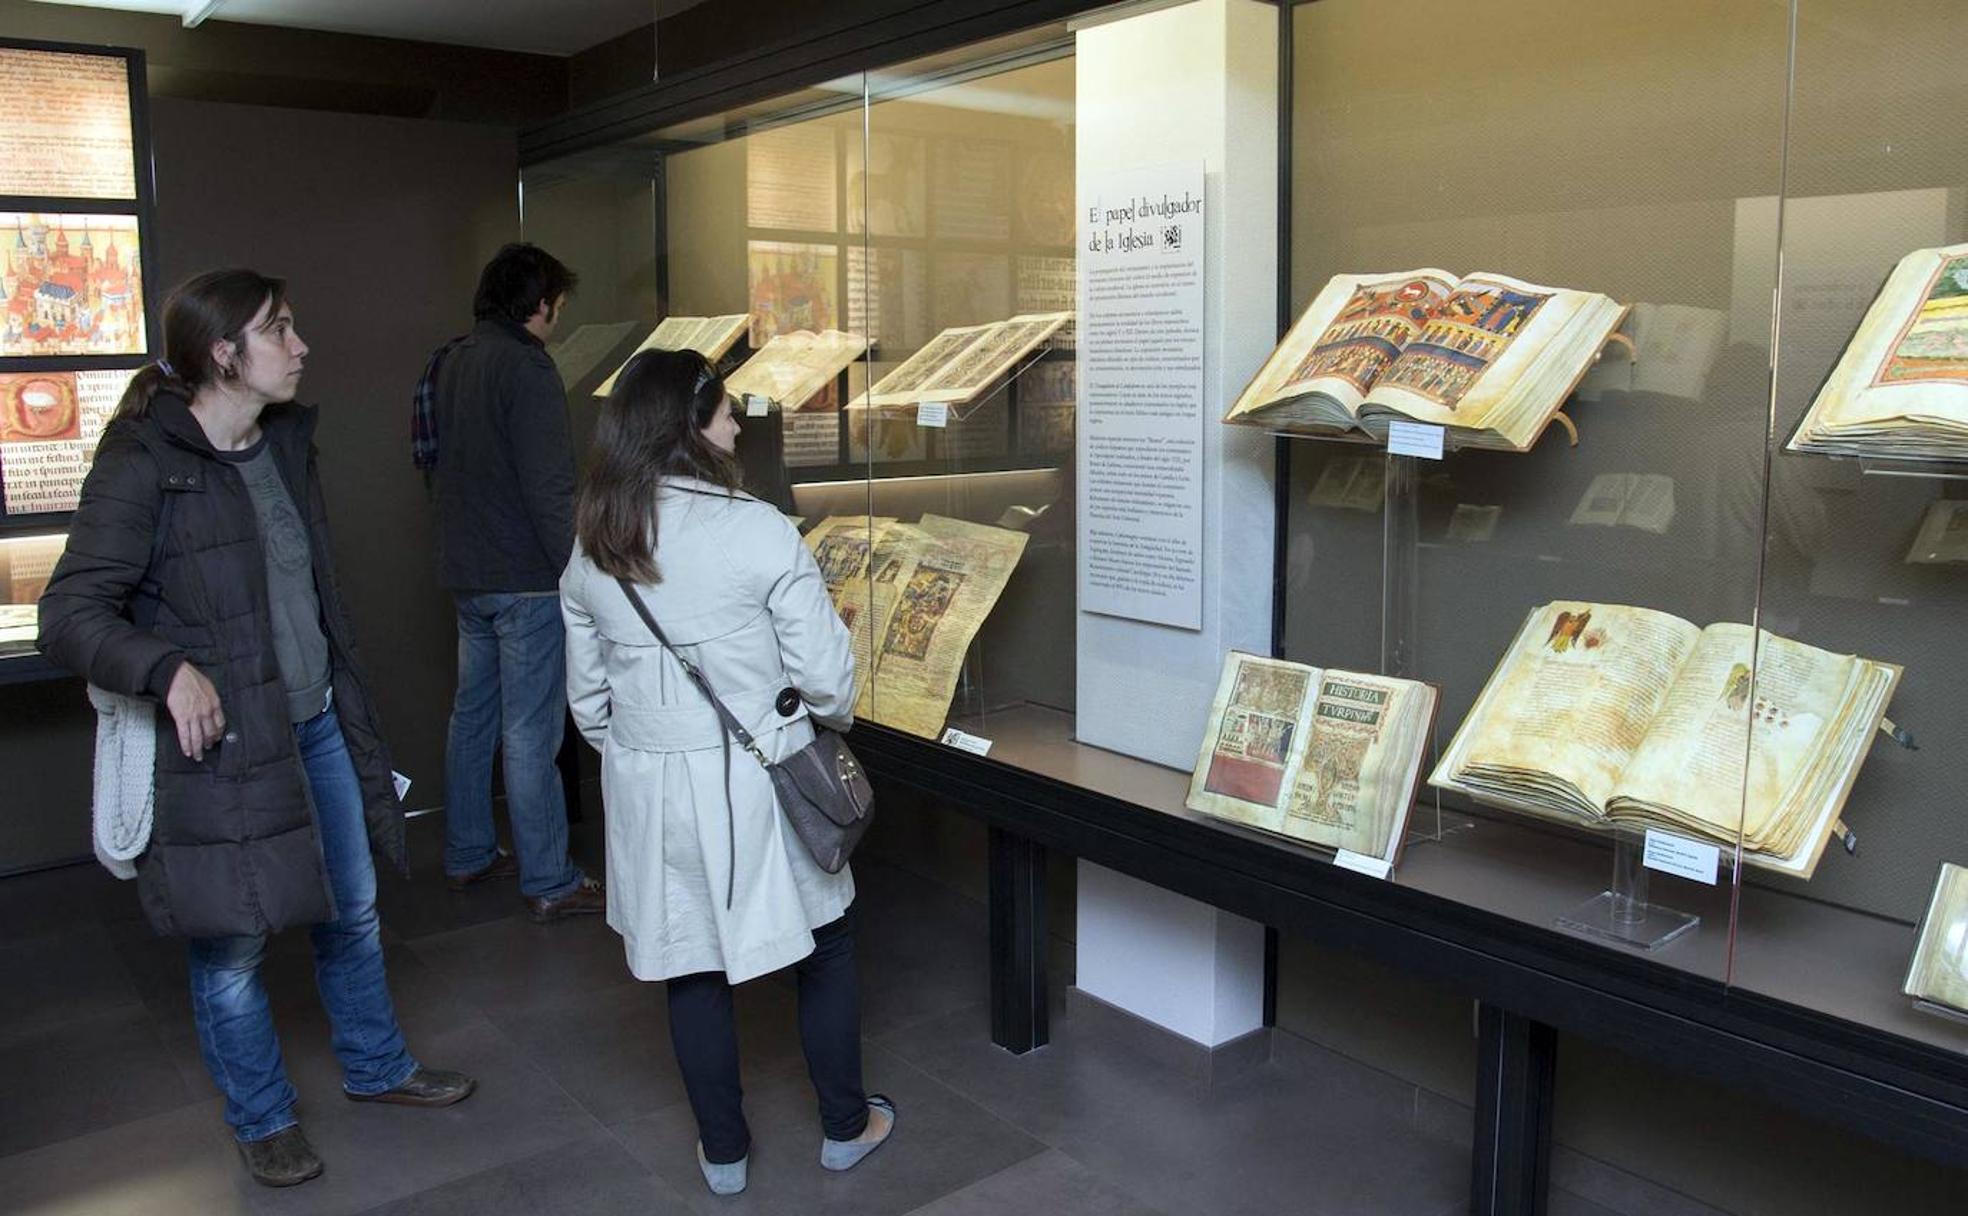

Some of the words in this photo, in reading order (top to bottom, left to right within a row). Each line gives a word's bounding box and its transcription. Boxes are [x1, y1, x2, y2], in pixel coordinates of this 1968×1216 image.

[1106, 197, 1135, 226] papel
[1138, 191, 1202, 220] divulgador
[1089, 231, 1102, 252] de
[1104, 230, 1114, 253] la
[1119, 227, 1154, 252] Iglesia
[1330, 684, 1379, 703] HISTORIA
